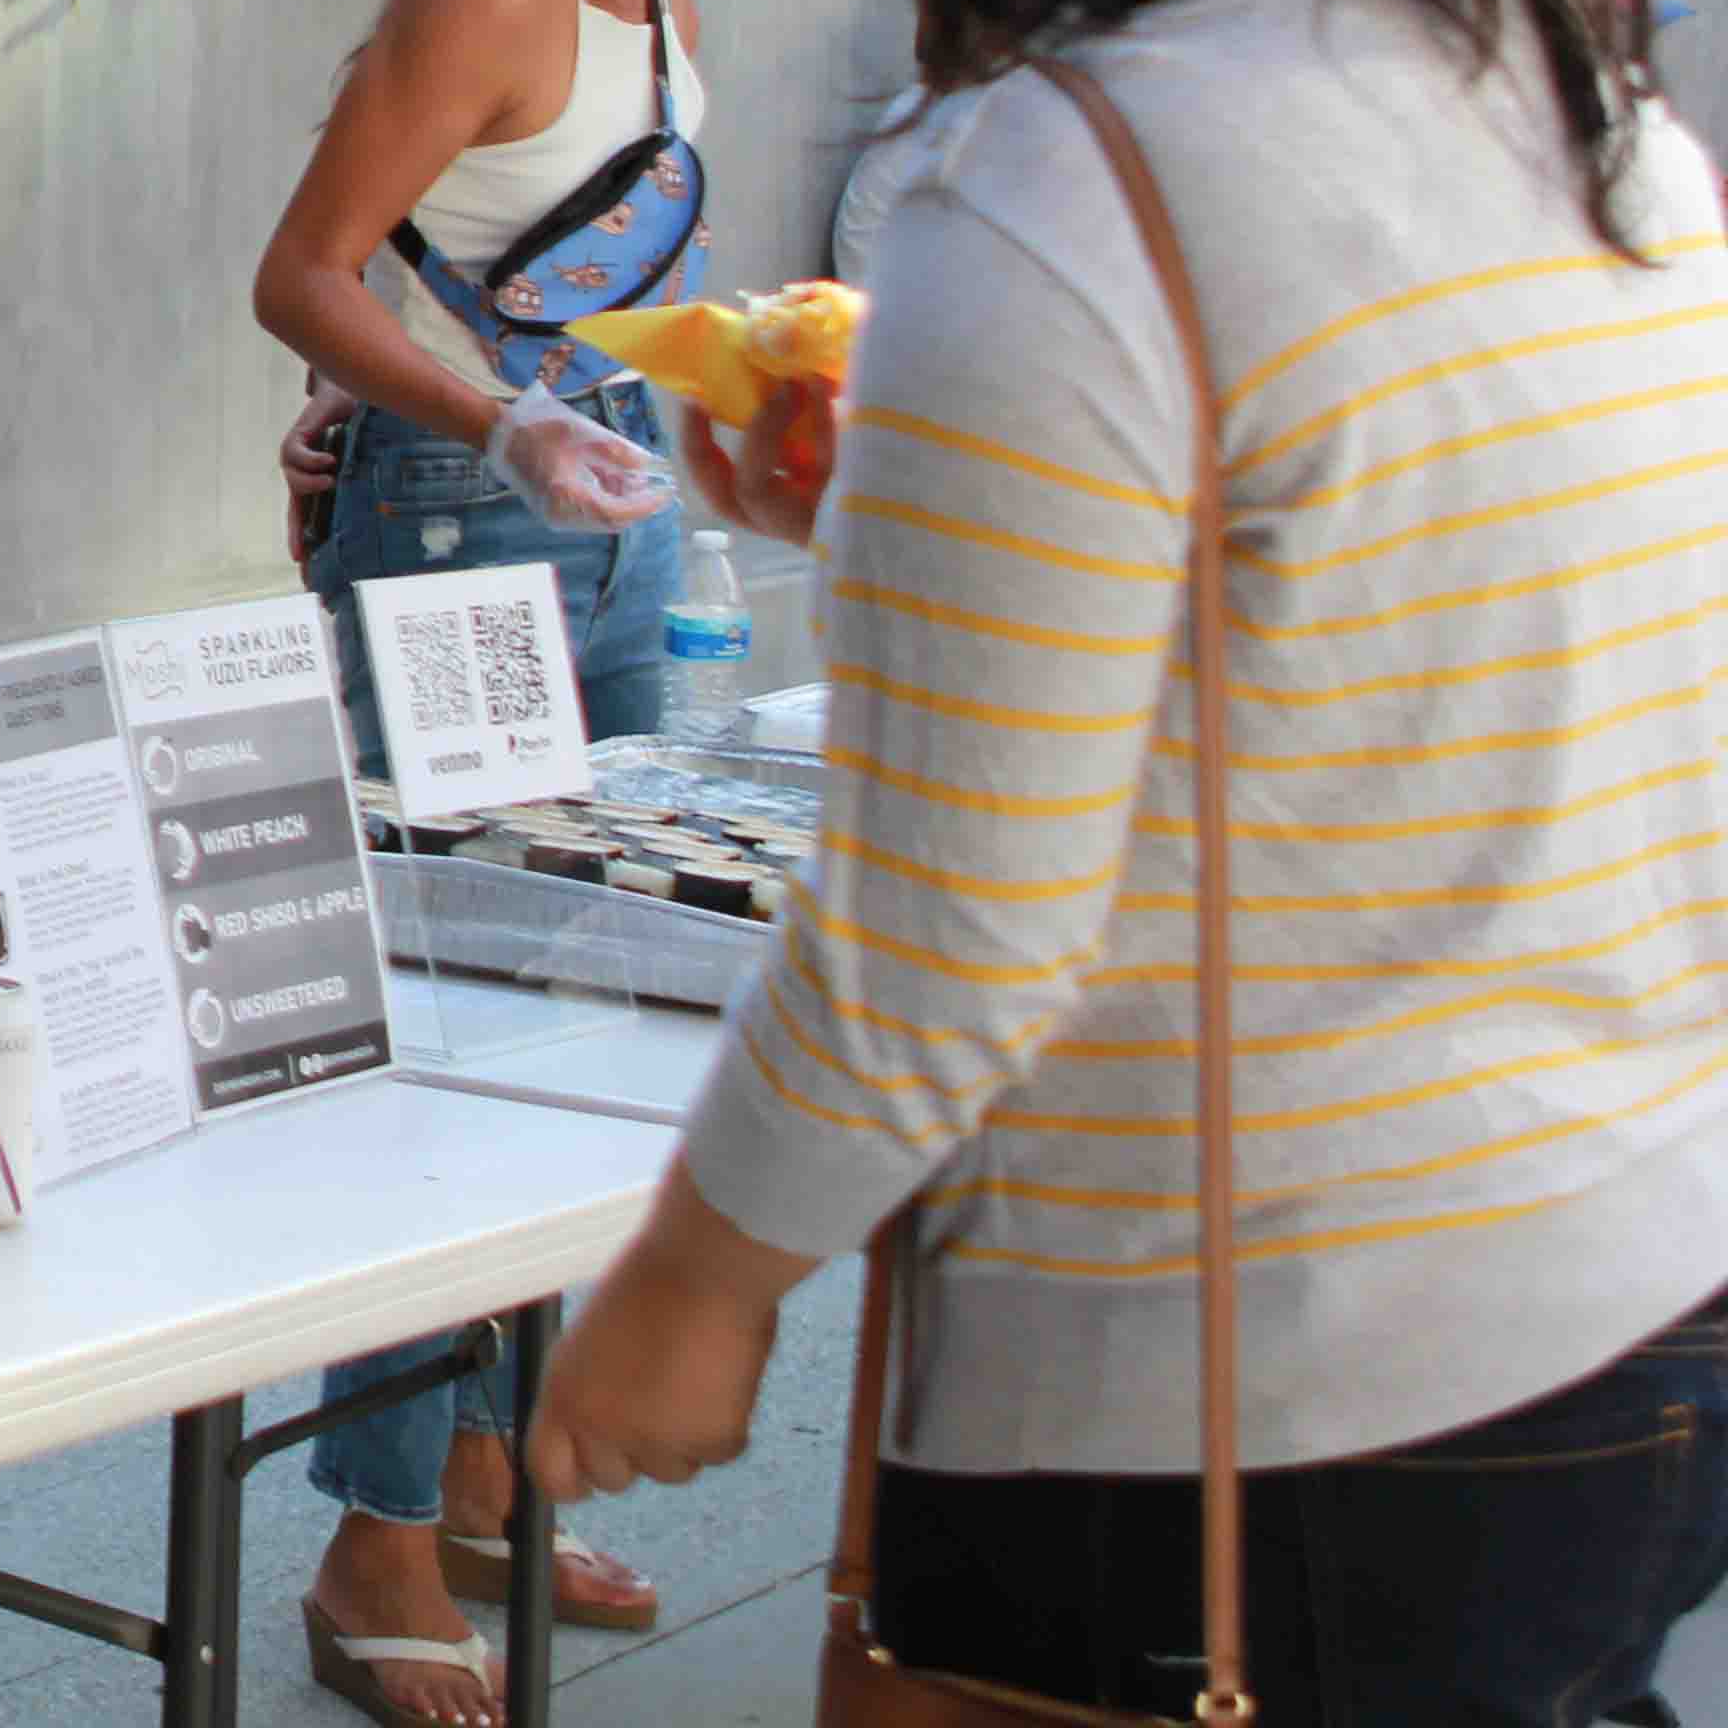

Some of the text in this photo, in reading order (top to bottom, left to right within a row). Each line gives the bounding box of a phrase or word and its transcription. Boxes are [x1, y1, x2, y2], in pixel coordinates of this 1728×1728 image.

[198, 622, 312, 660] SPARKLING
[203, 652, 317, 687] YUZU FLAVORS
[184, 738, 261, 772] ORIGINAL
[199, 813, 308, 856] WHITE PEACH
[215, 908, 249, 938] RED
[316, 885, 367, 916] APPLE
[228, 975, 349, 1024] UNSWEETENED
